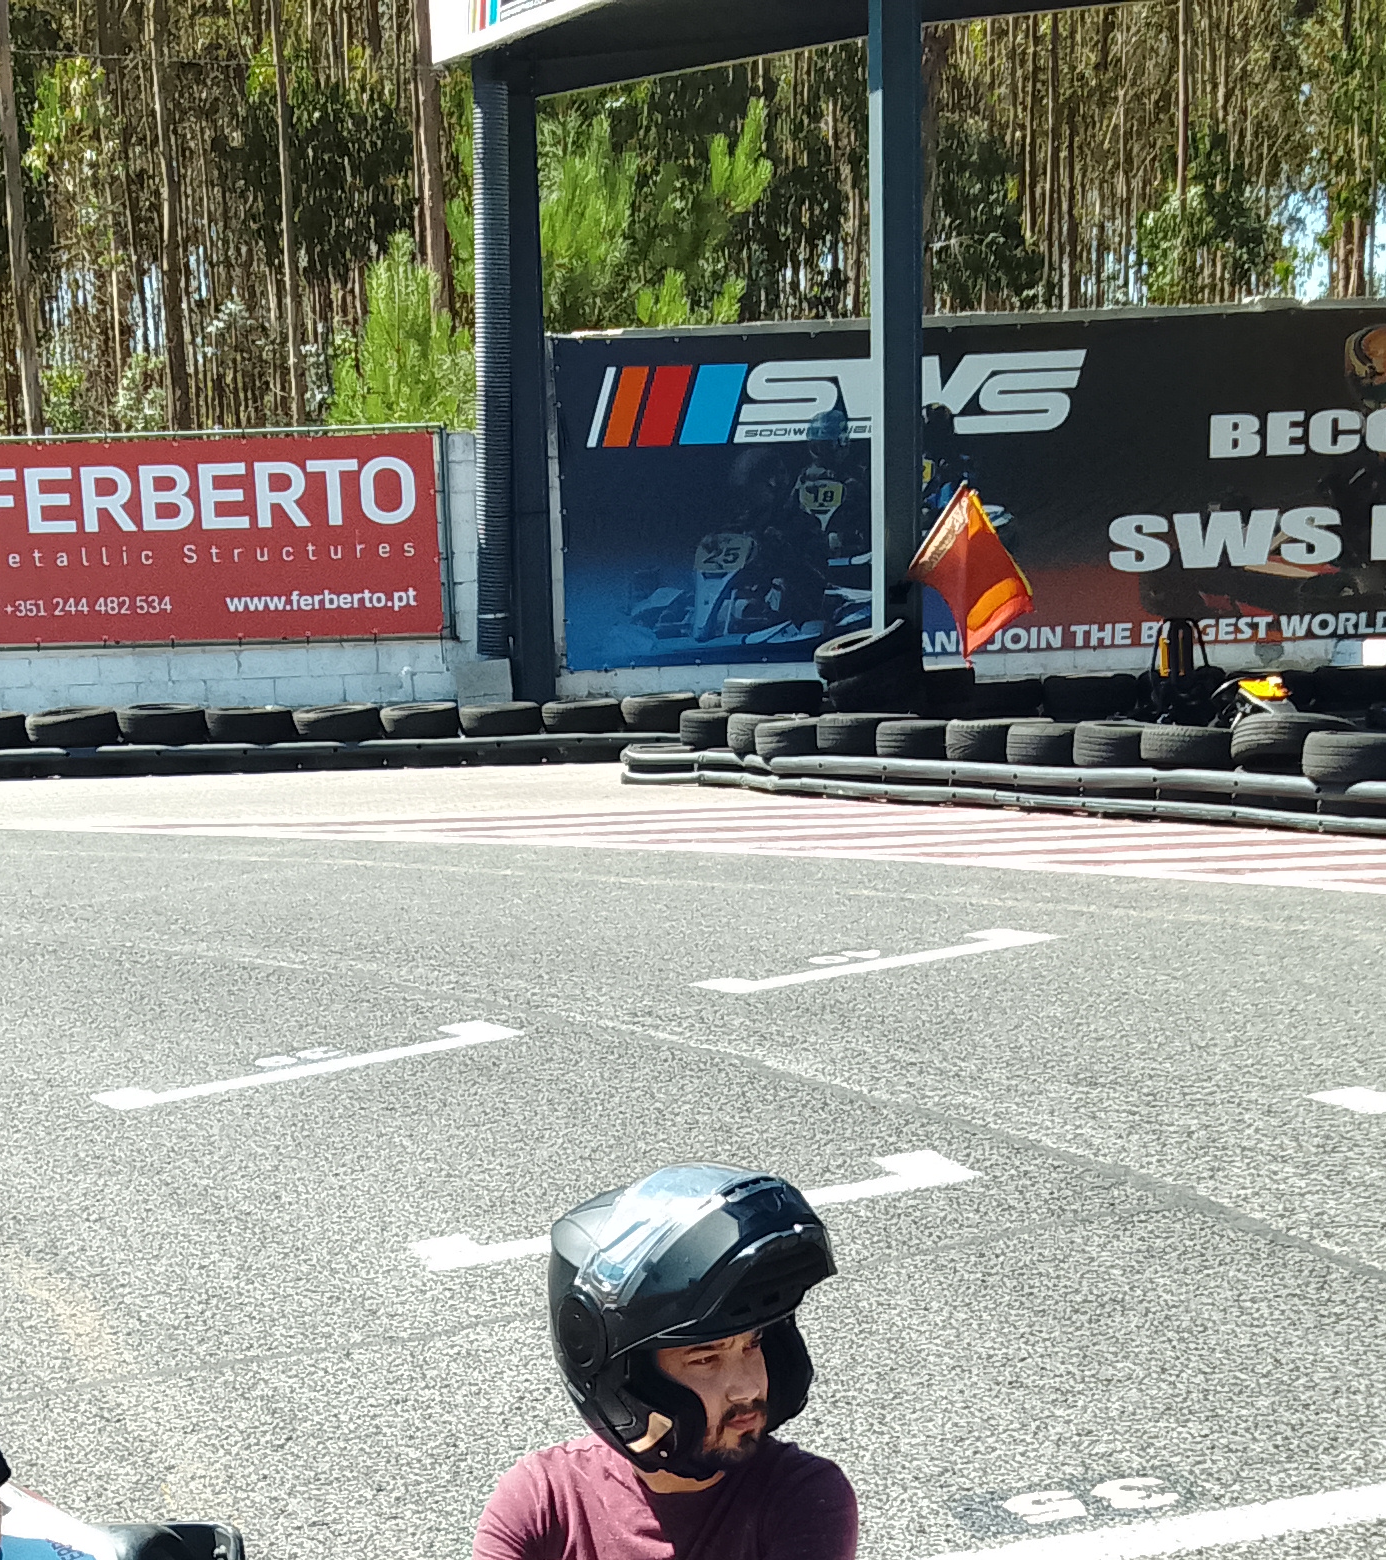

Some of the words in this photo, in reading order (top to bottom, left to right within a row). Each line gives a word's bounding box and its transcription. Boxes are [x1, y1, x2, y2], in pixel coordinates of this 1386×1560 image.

[183, 539, 416, 563] Structures
[1109, 505, 1343, 573] SWS
[3, 599, 48, 617] +351
[53, 598, 90, 617] 244
[95, 596, 133, 615] 482
[136, 594, 173, 614] 534
[225, 586, 418, 615] www.ferberto.pt
[922, 631, 964, 653] AN
[987, 624, 1063, 652] JOIN
[1070, 621, 1133, 647] THE
[1140, 614, 1273, 644] BIGEST
